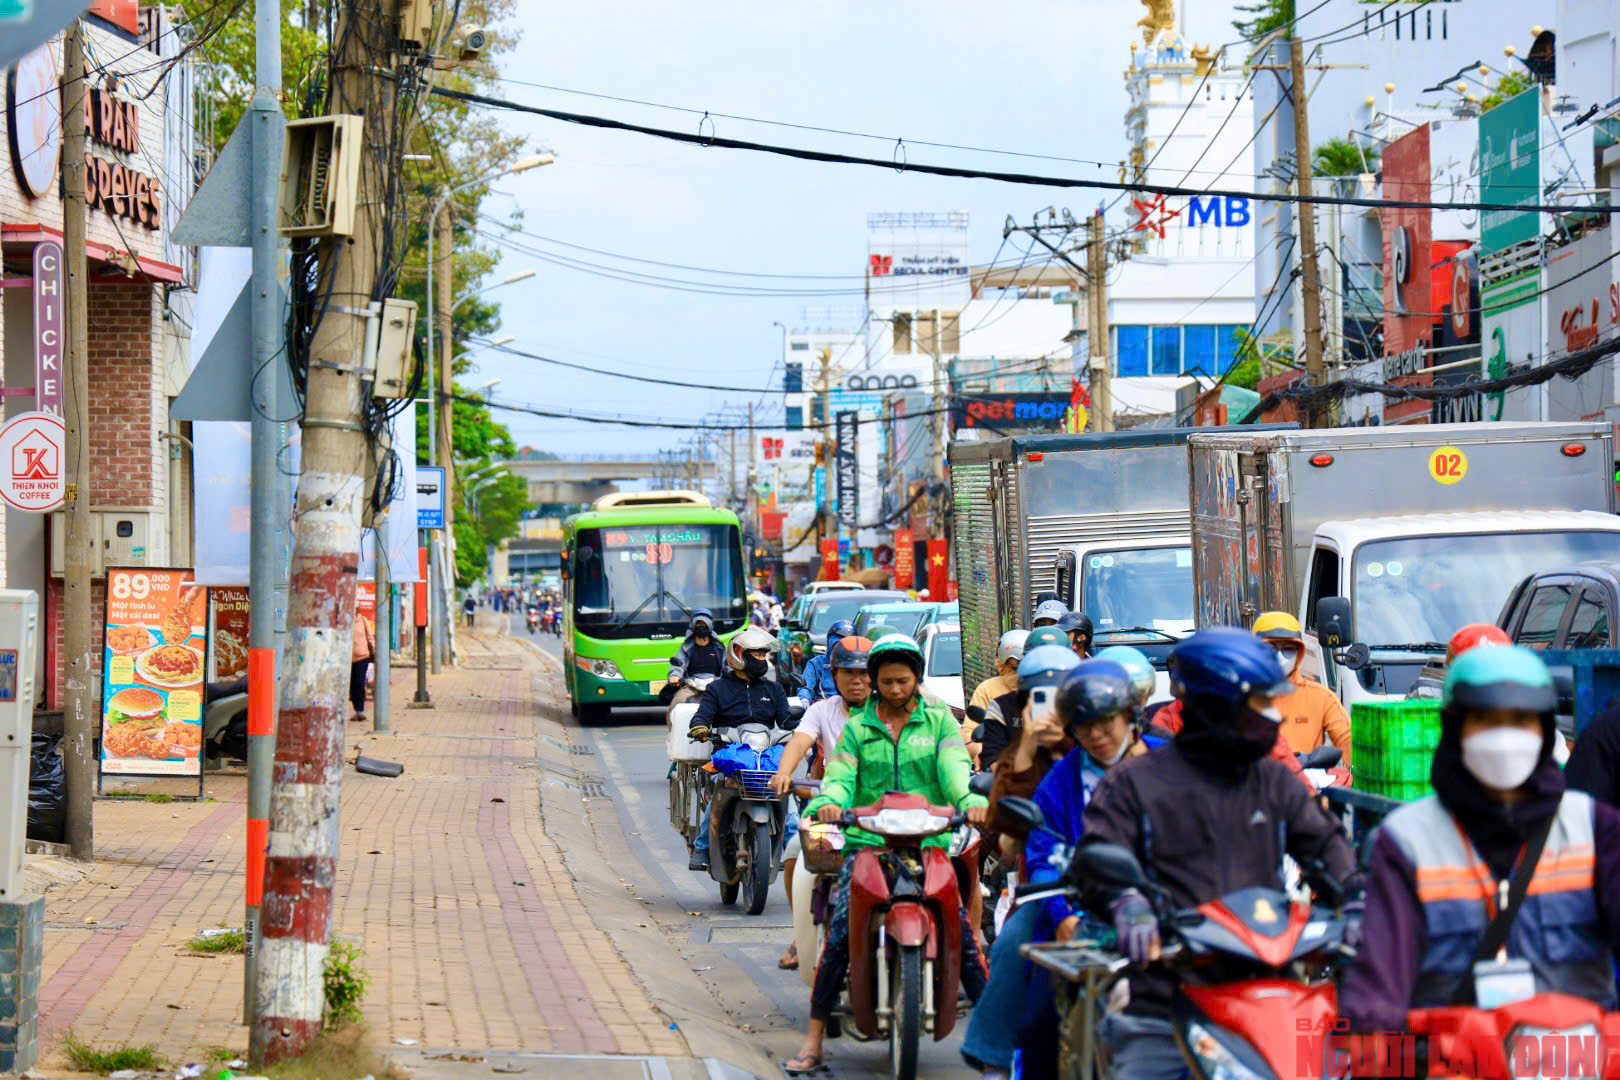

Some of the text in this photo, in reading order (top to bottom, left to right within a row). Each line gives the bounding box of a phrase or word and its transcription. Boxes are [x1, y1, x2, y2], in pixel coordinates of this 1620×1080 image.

[1188, 194, 1250, 228] MB
[894, 266, 969, 276] SEOUL CENTER
[1435, 454, 1462, 477] 02
[19, 491, 51, 500] COFFEE
[112, 573, 150, 599] 89
